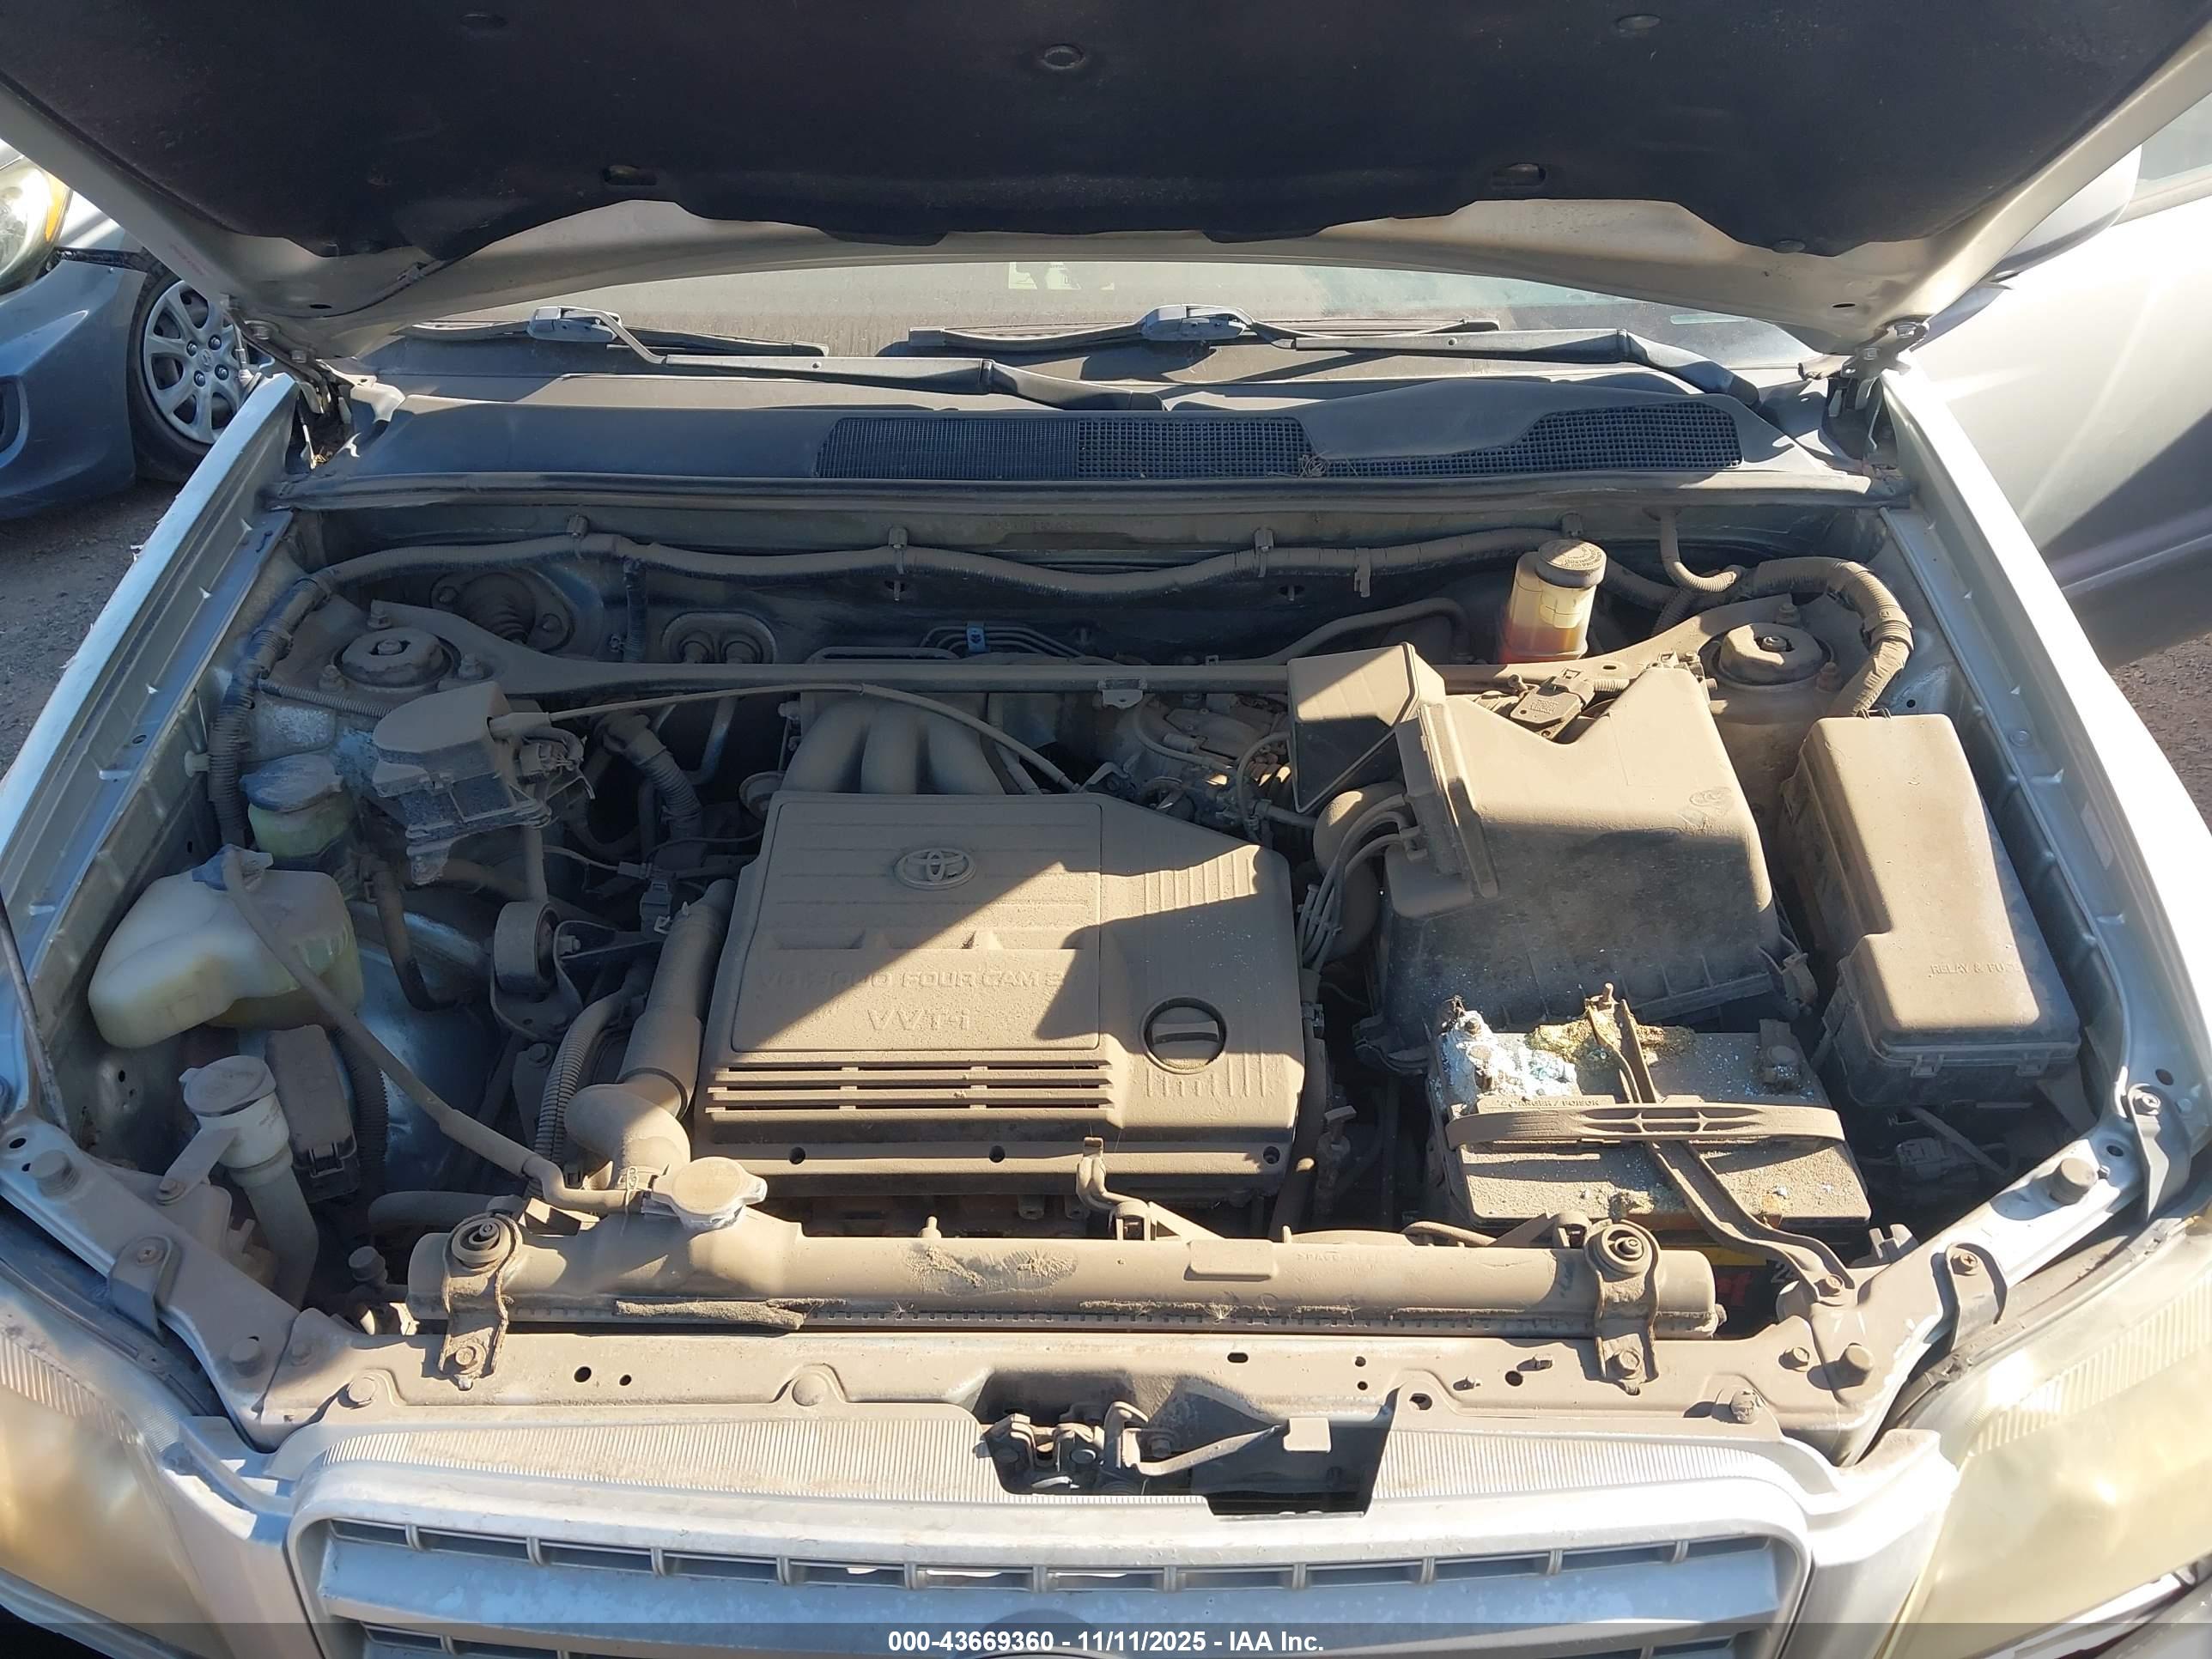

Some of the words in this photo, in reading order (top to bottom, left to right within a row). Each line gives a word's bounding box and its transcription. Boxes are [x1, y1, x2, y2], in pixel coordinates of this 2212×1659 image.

[1929, 963, 1969, 975] RELAY
[1973, 962, 1984, 974] &
[902, 969, 975, 988] FOUR
[981, 969, 1042, 988] CAM
